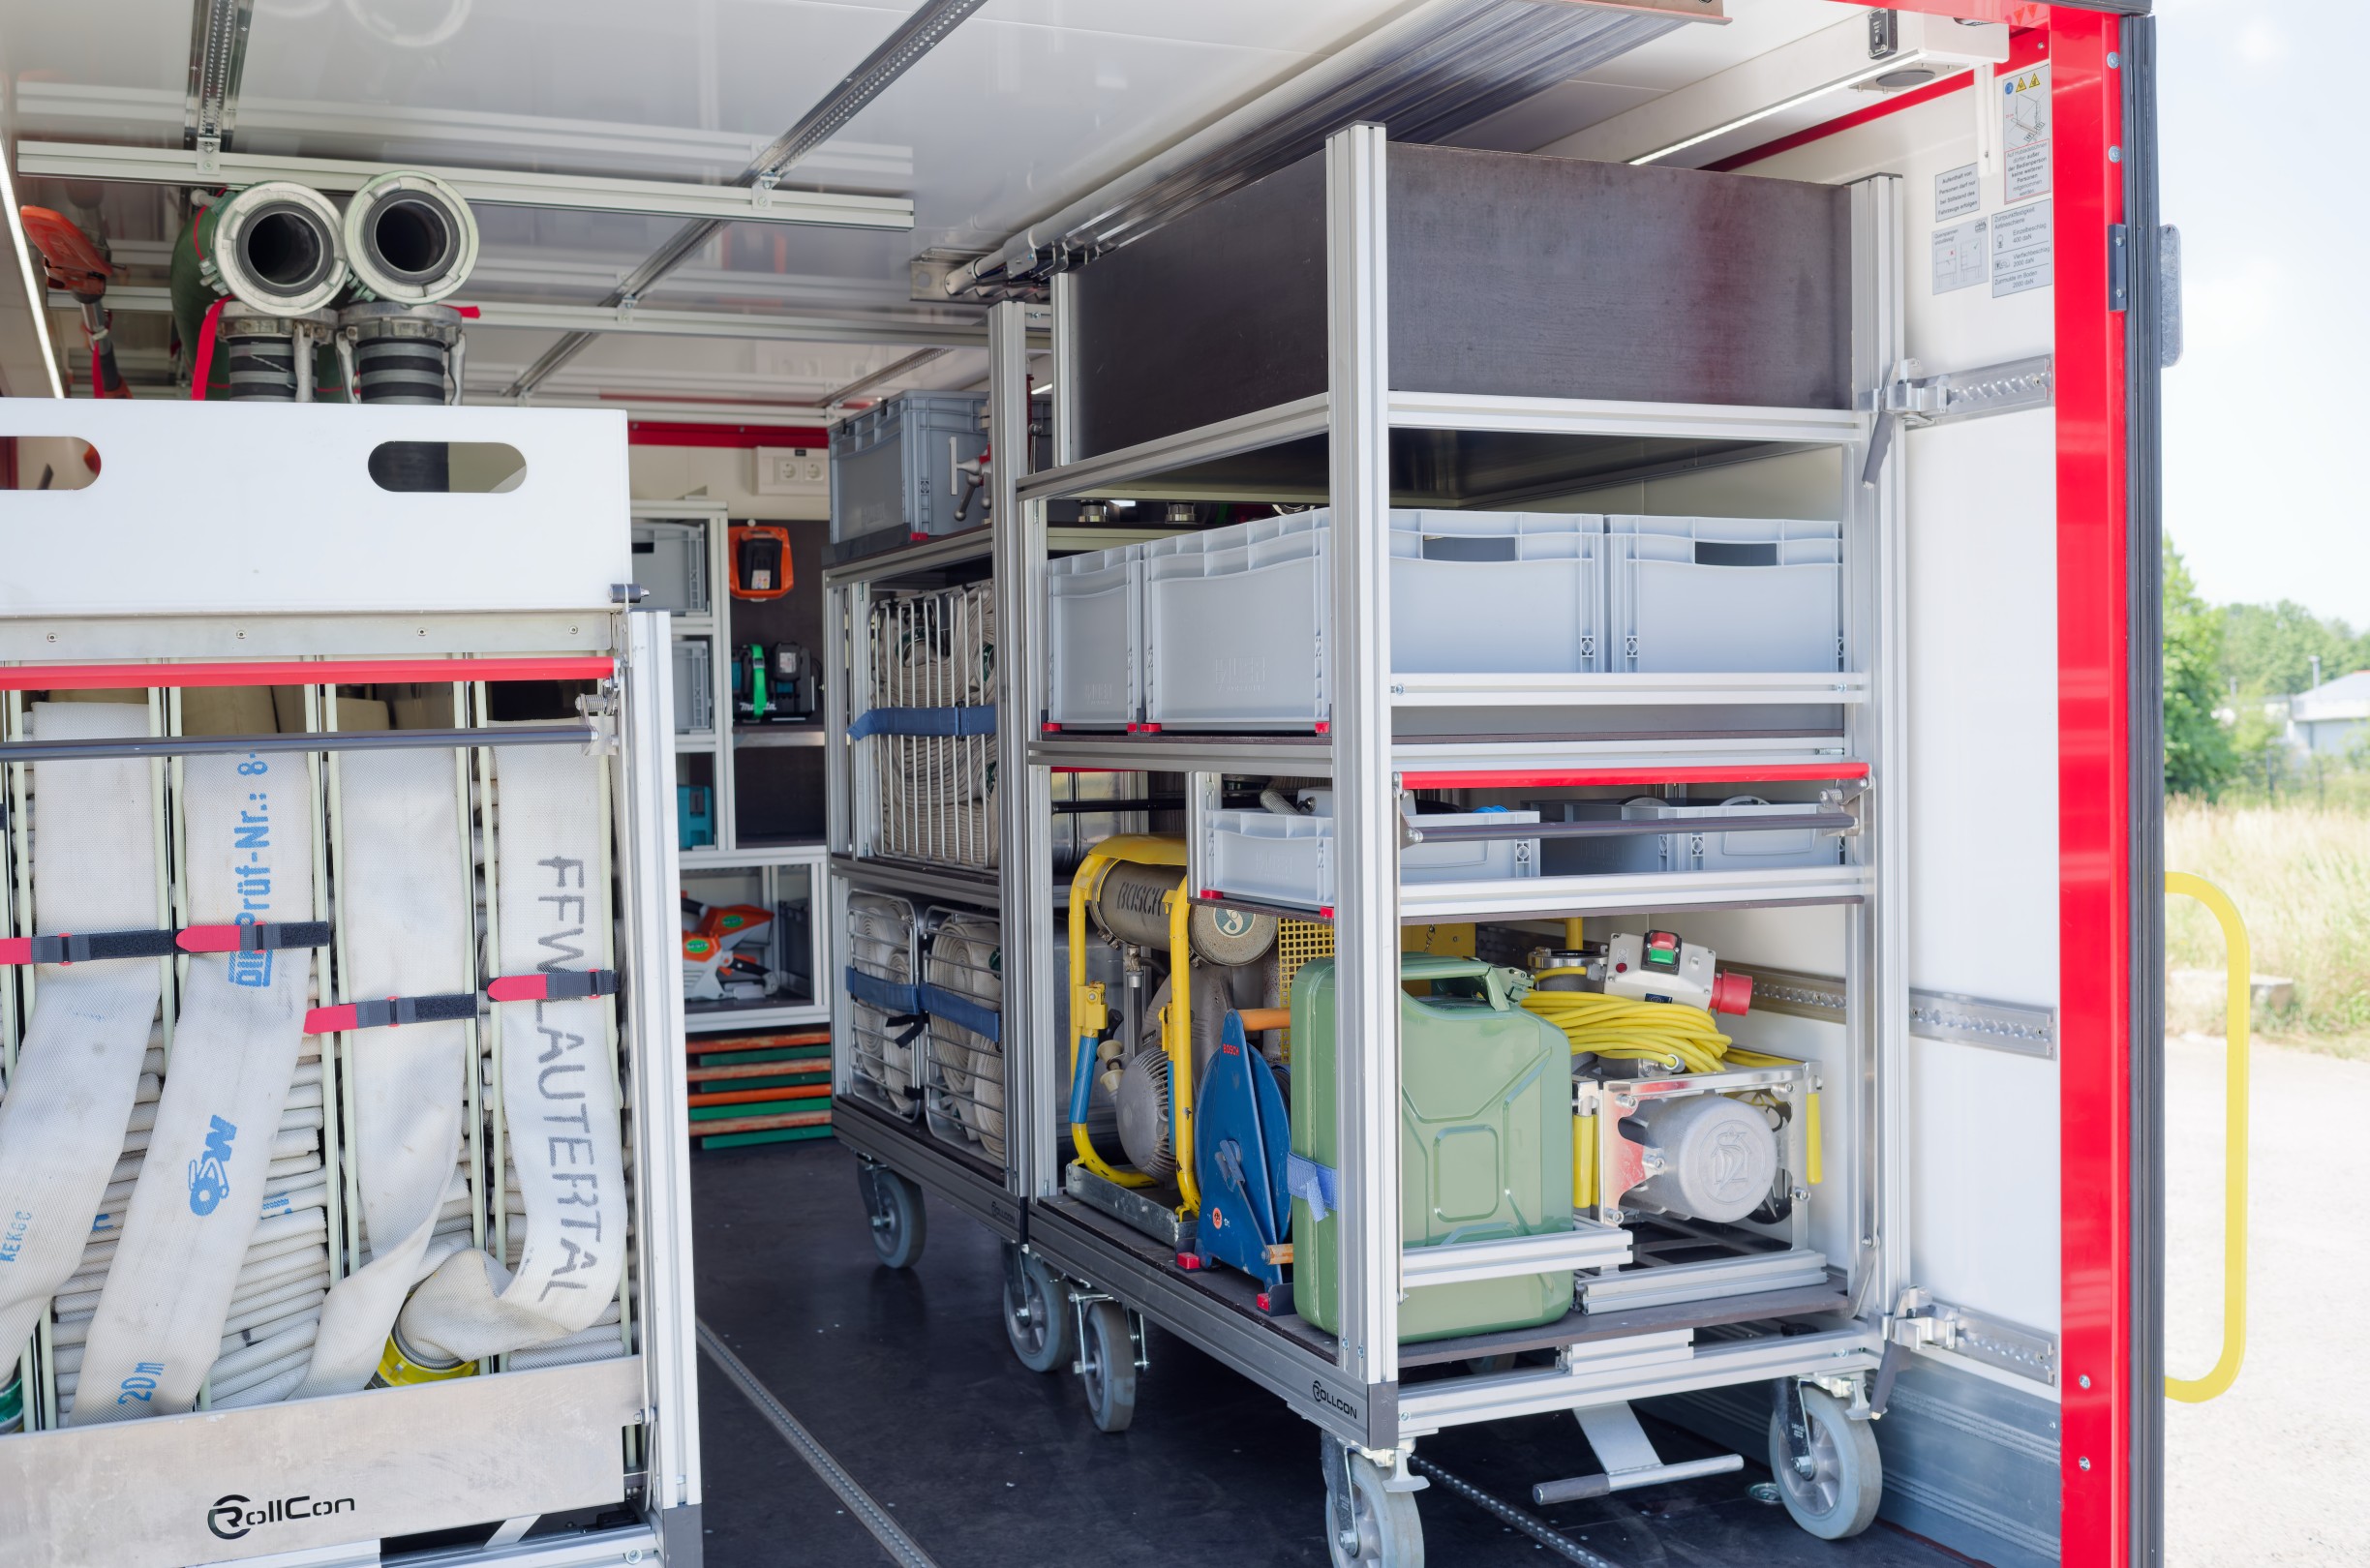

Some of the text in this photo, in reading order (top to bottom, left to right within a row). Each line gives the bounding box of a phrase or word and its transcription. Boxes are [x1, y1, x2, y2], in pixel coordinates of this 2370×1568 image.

[739, 702, 777, 711] Mata
[1116, 881, 1167, 917] BOSCH
[1223, 1043, 1240, 1056] BOSCH
[535, 998, 601, 1302] LAUTERTAL
[1313, 1380, 1357, 1420] ROLLCON
[208, 1494, 355, 1540] RollCon
